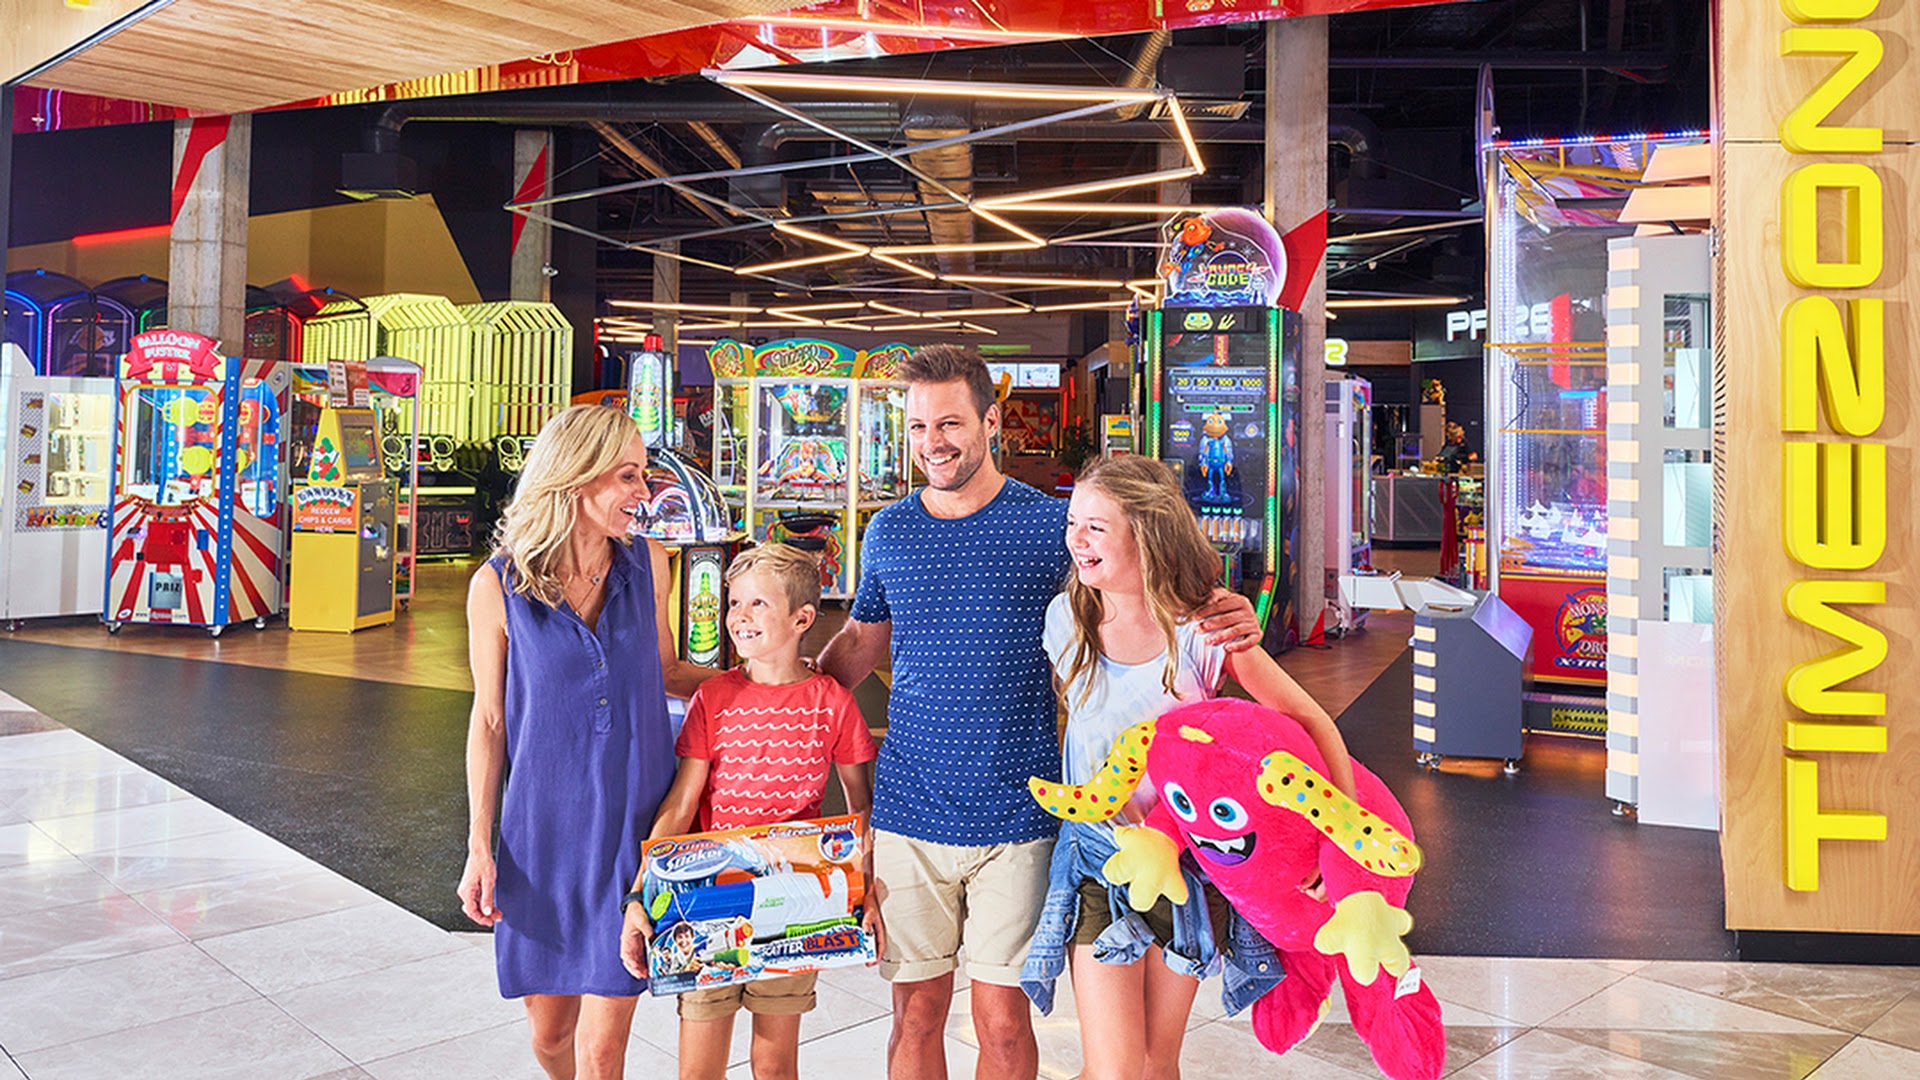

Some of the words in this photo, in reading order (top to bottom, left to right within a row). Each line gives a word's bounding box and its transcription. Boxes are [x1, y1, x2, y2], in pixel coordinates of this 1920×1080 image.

[1206, 273, 1250, 286] CODE
[137, 333, 201, 349] BALLOON
[144, 346, 191, 359] BUSTER
[1778, 0, 1888, 892] TIMEZON
[310, 507, 340, 515] REDEEM
[26, 512, 98, 528] MASTER
[298, 515, 319, 524] CHIPS
[327, 517, 353, 525] CARDS
[314, 525, 335, 533] HERE
[155, 582, 181, 592] PRIZ
[1569, 602, 1608, 618] MONS
[1563, 714, 1595, 724] PLEASE
[805, 930, 860, 952] BLAST
